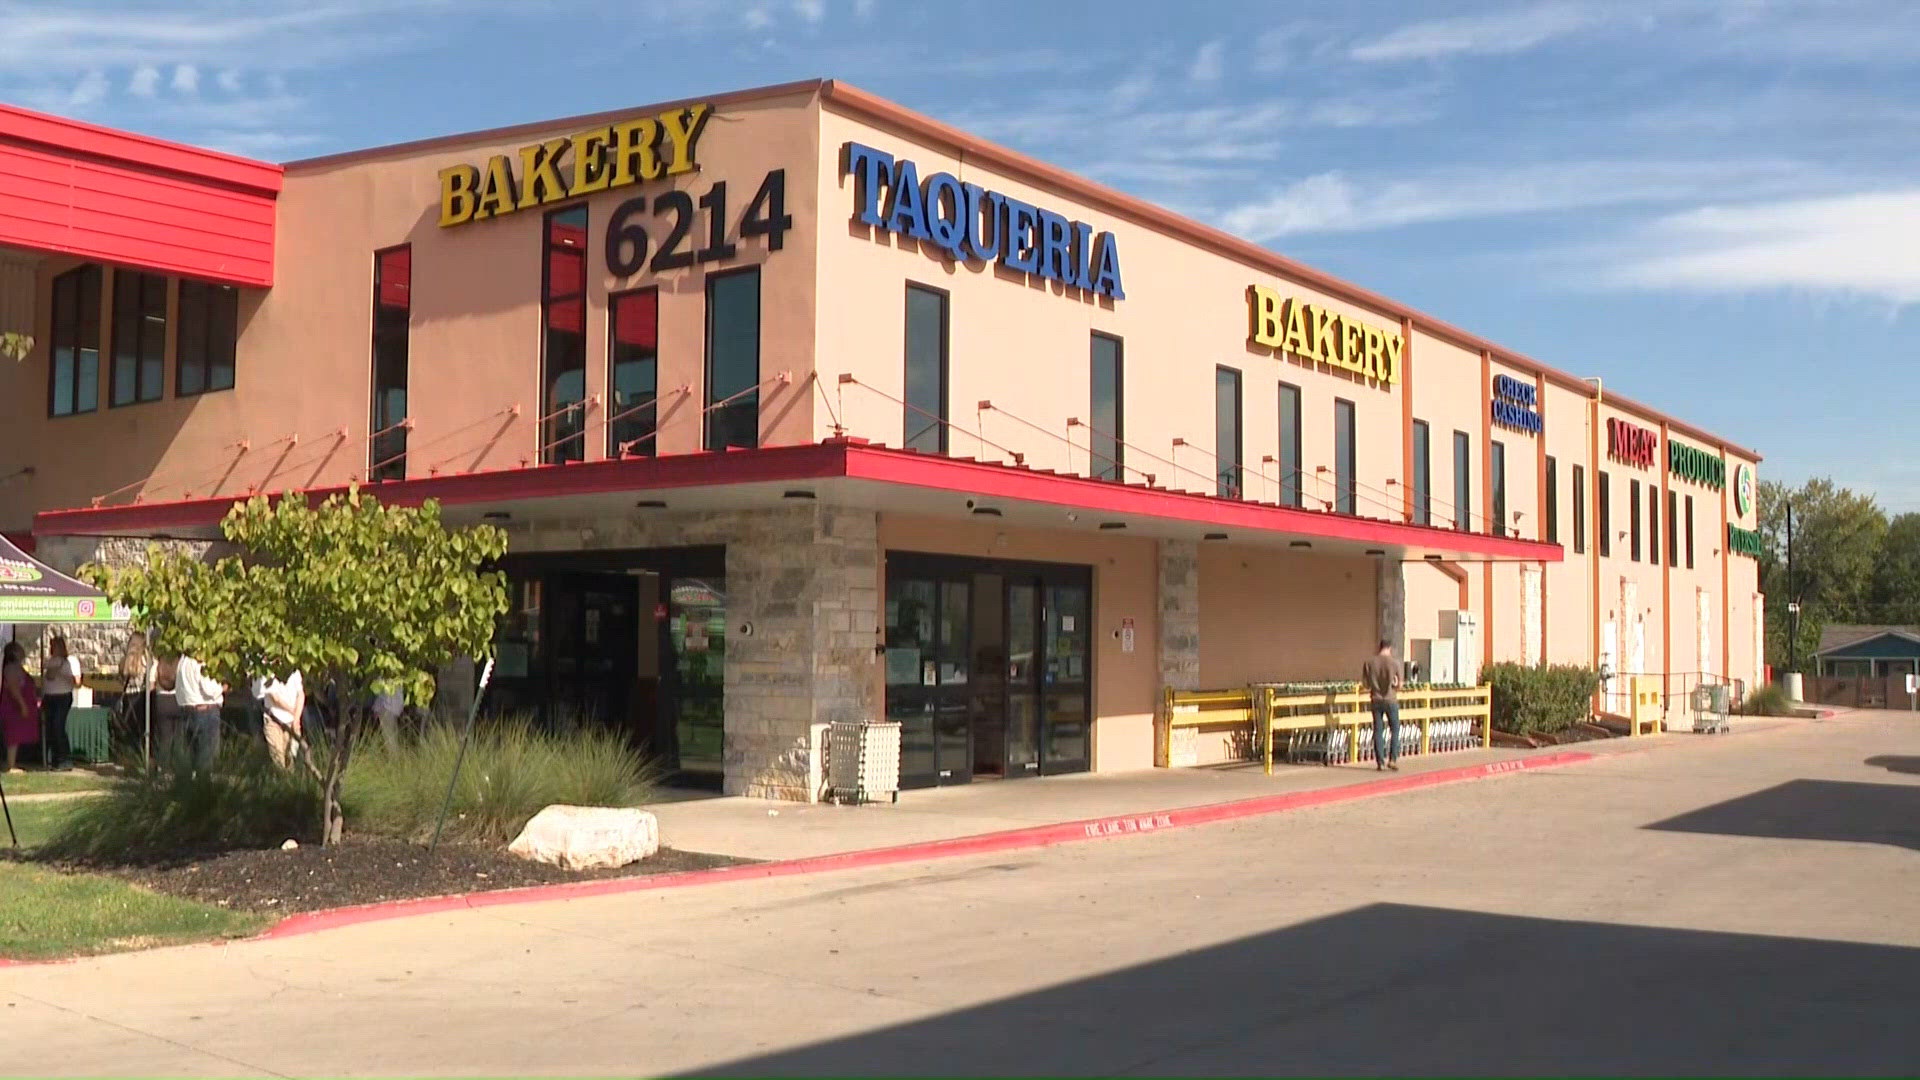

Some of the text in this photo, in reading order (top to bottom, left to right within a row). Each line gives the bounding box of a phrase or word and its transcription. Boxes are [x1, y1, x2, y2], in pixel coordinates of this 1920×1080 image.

[437, 103, 712, 228] BAKERY
[604, 167, 793, 279] 6214
[844, 141, 1126, 300] TAQUERIA
[1247, 284, 1406, 385] BAKERY
[1493, 398, 1543, 433] CASHING
[1498, 374, 1537, 406] CHECK
[1612, 417, 1657, 467] MEAT
[1669, 439, 1727, 489] PRODUCE
